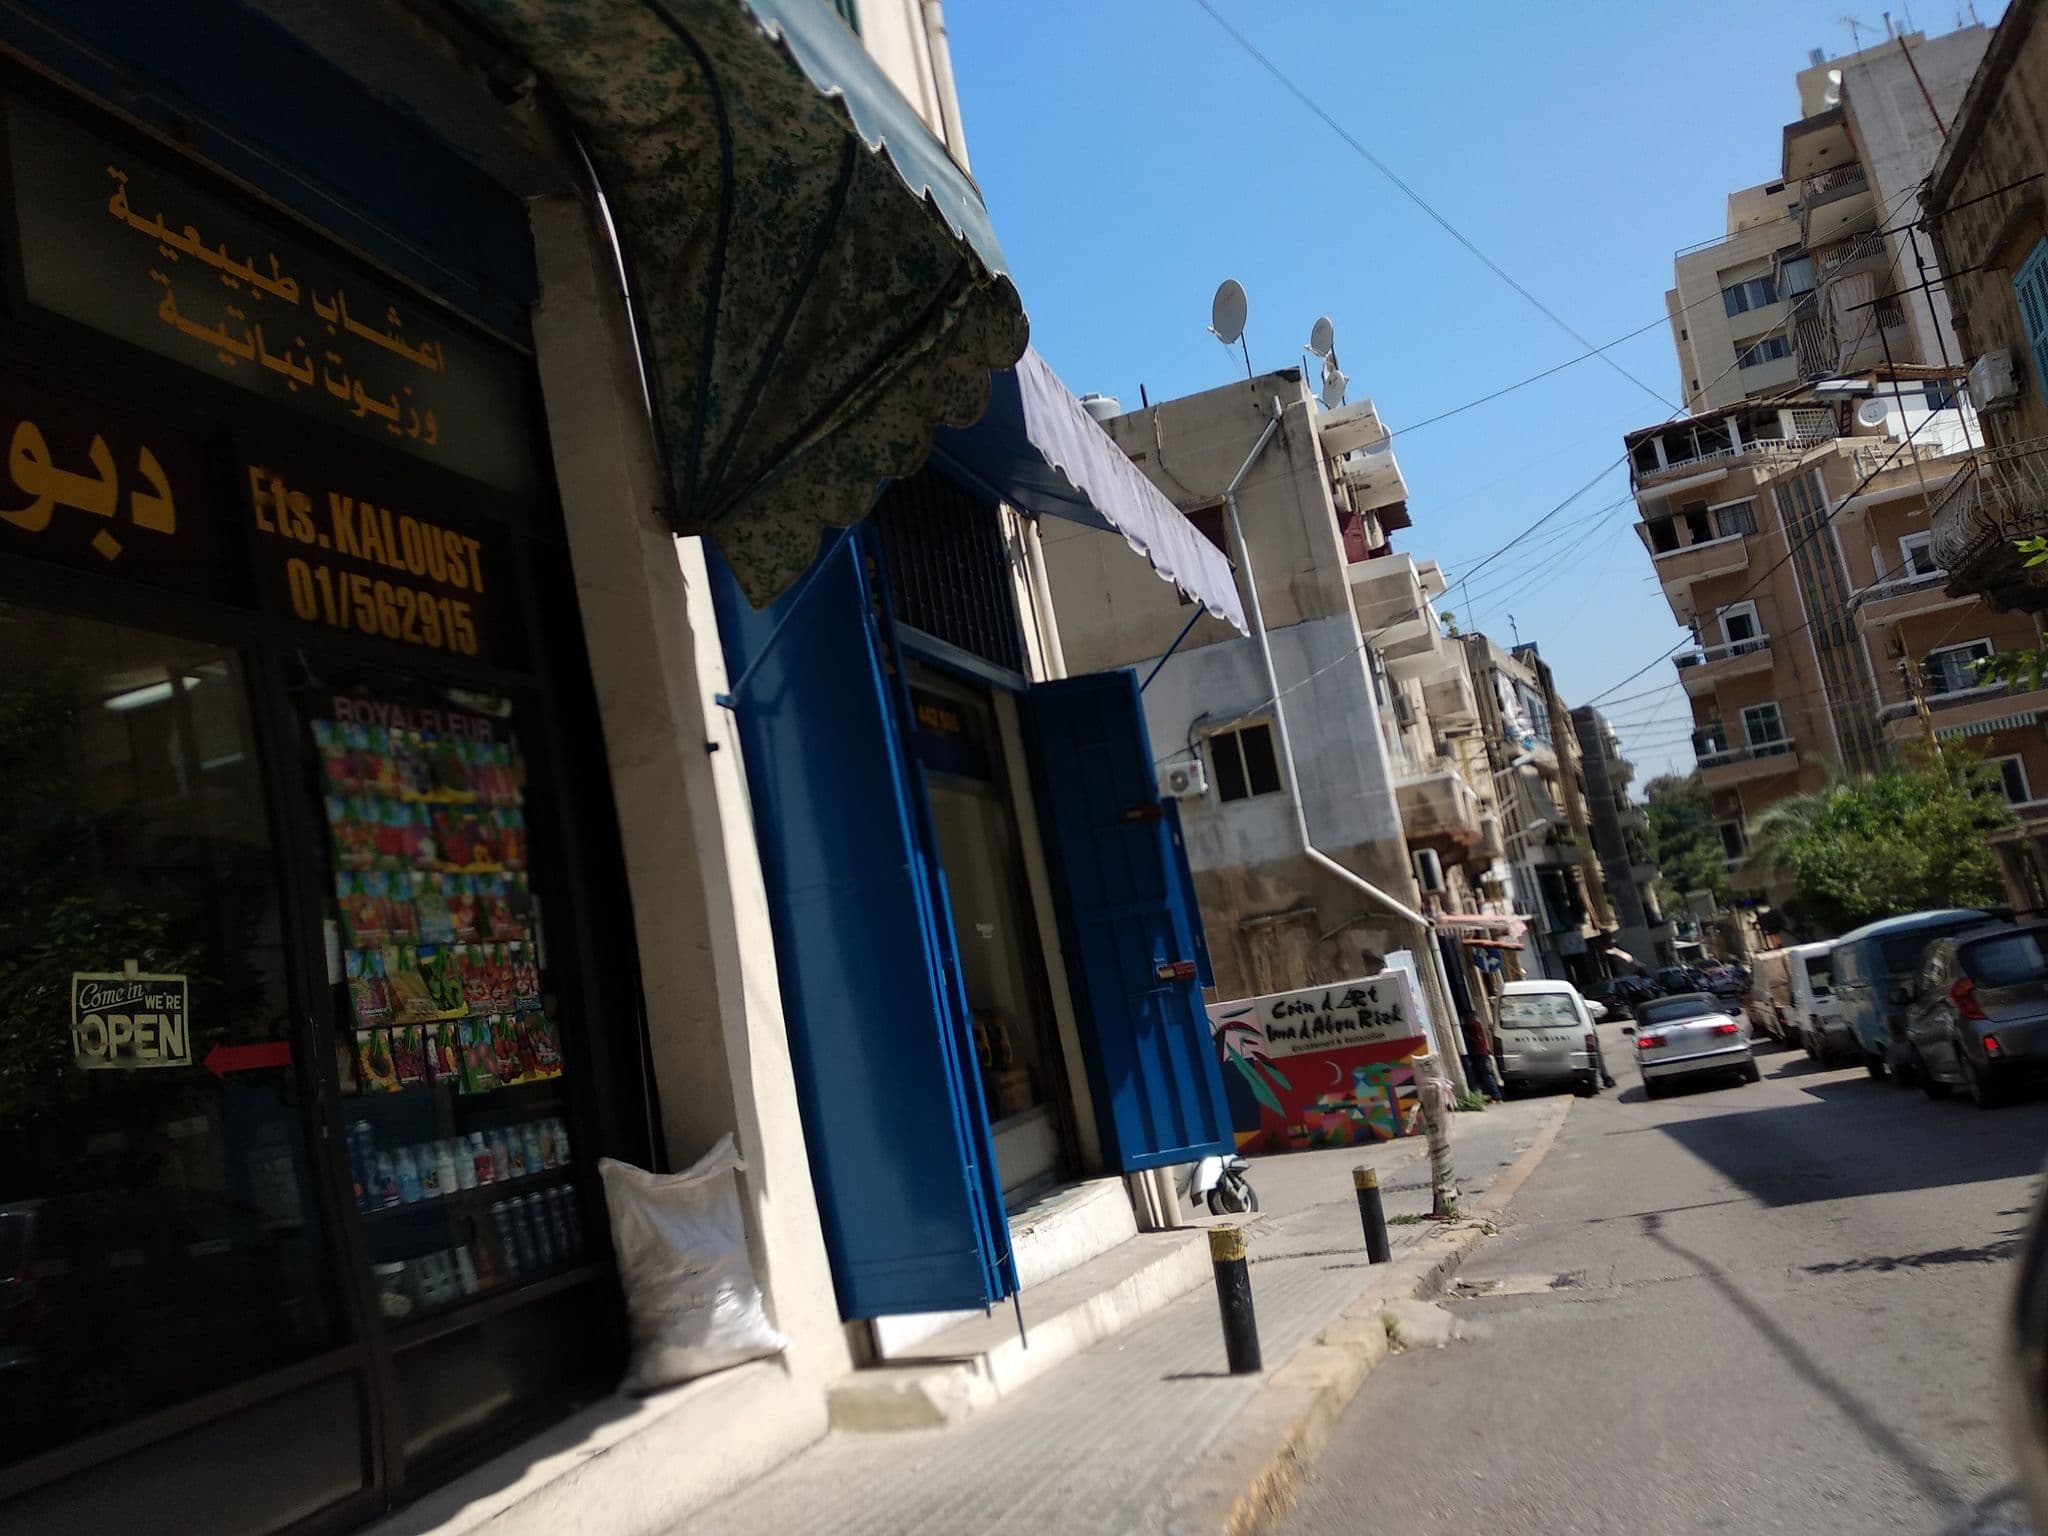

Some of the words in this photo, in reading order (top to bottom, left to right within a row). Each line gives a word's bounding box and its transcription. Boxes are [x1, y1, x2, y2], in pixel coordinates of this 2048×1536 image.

[104, 163, 301, 304] طبيعية
[145, 265, 314, 392] نباتية
[322, 350, 439, 446] وزيوت
[286, 558, 479, 656] 01/562915
[79, 983, 124, 1009] Come
[127, 983, 145, 999] in
[145, 993, 182, 1010] WE'RE
[79, 1013, 184, 1058] OPEN
